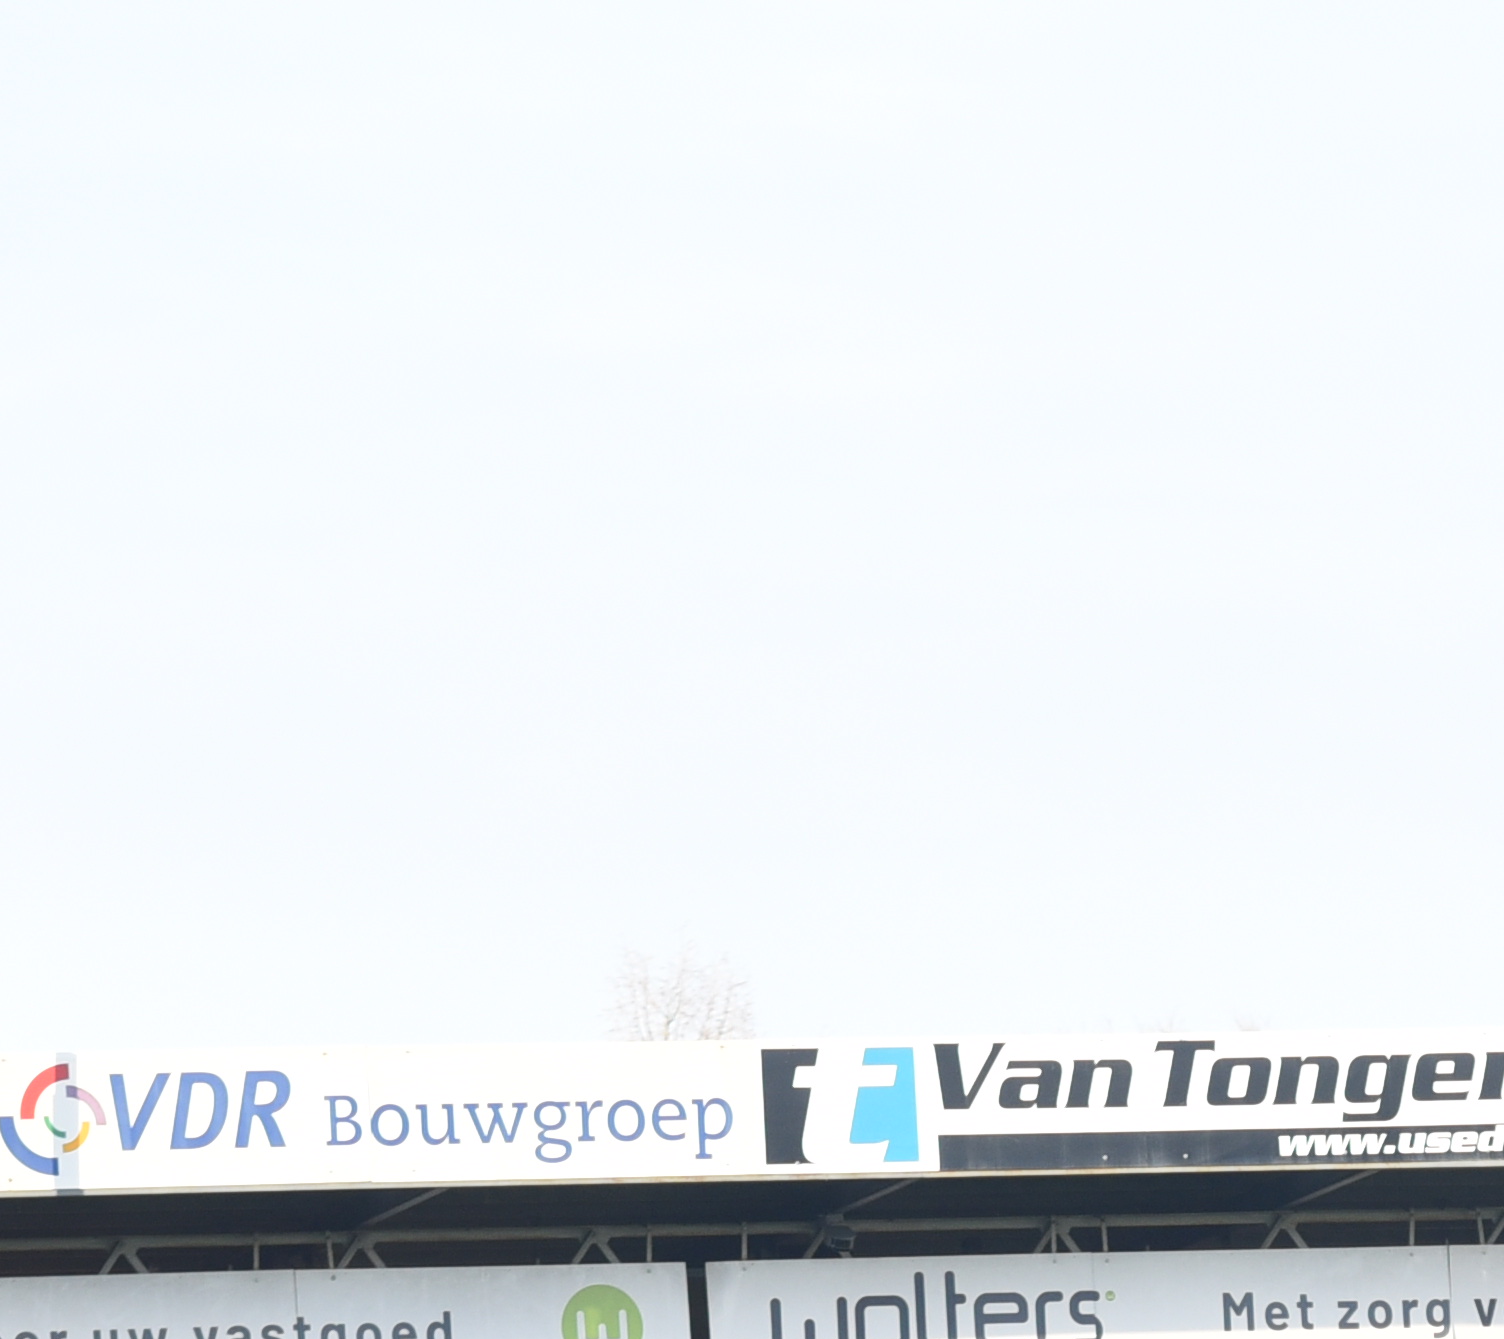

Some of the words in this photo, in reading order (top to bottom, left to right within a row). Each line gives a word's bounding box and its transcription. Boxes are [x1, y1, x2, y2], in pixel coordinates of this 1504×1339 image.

[108, 1069, 292, 1151] VDR
[933, 1042, 1133, 1112] Van
[325, 1094, 735, 1163] Bouwgroep
[1221, 1291, 1314, 1333] Met
[1337, 1292, 1453, 1338] zorg
